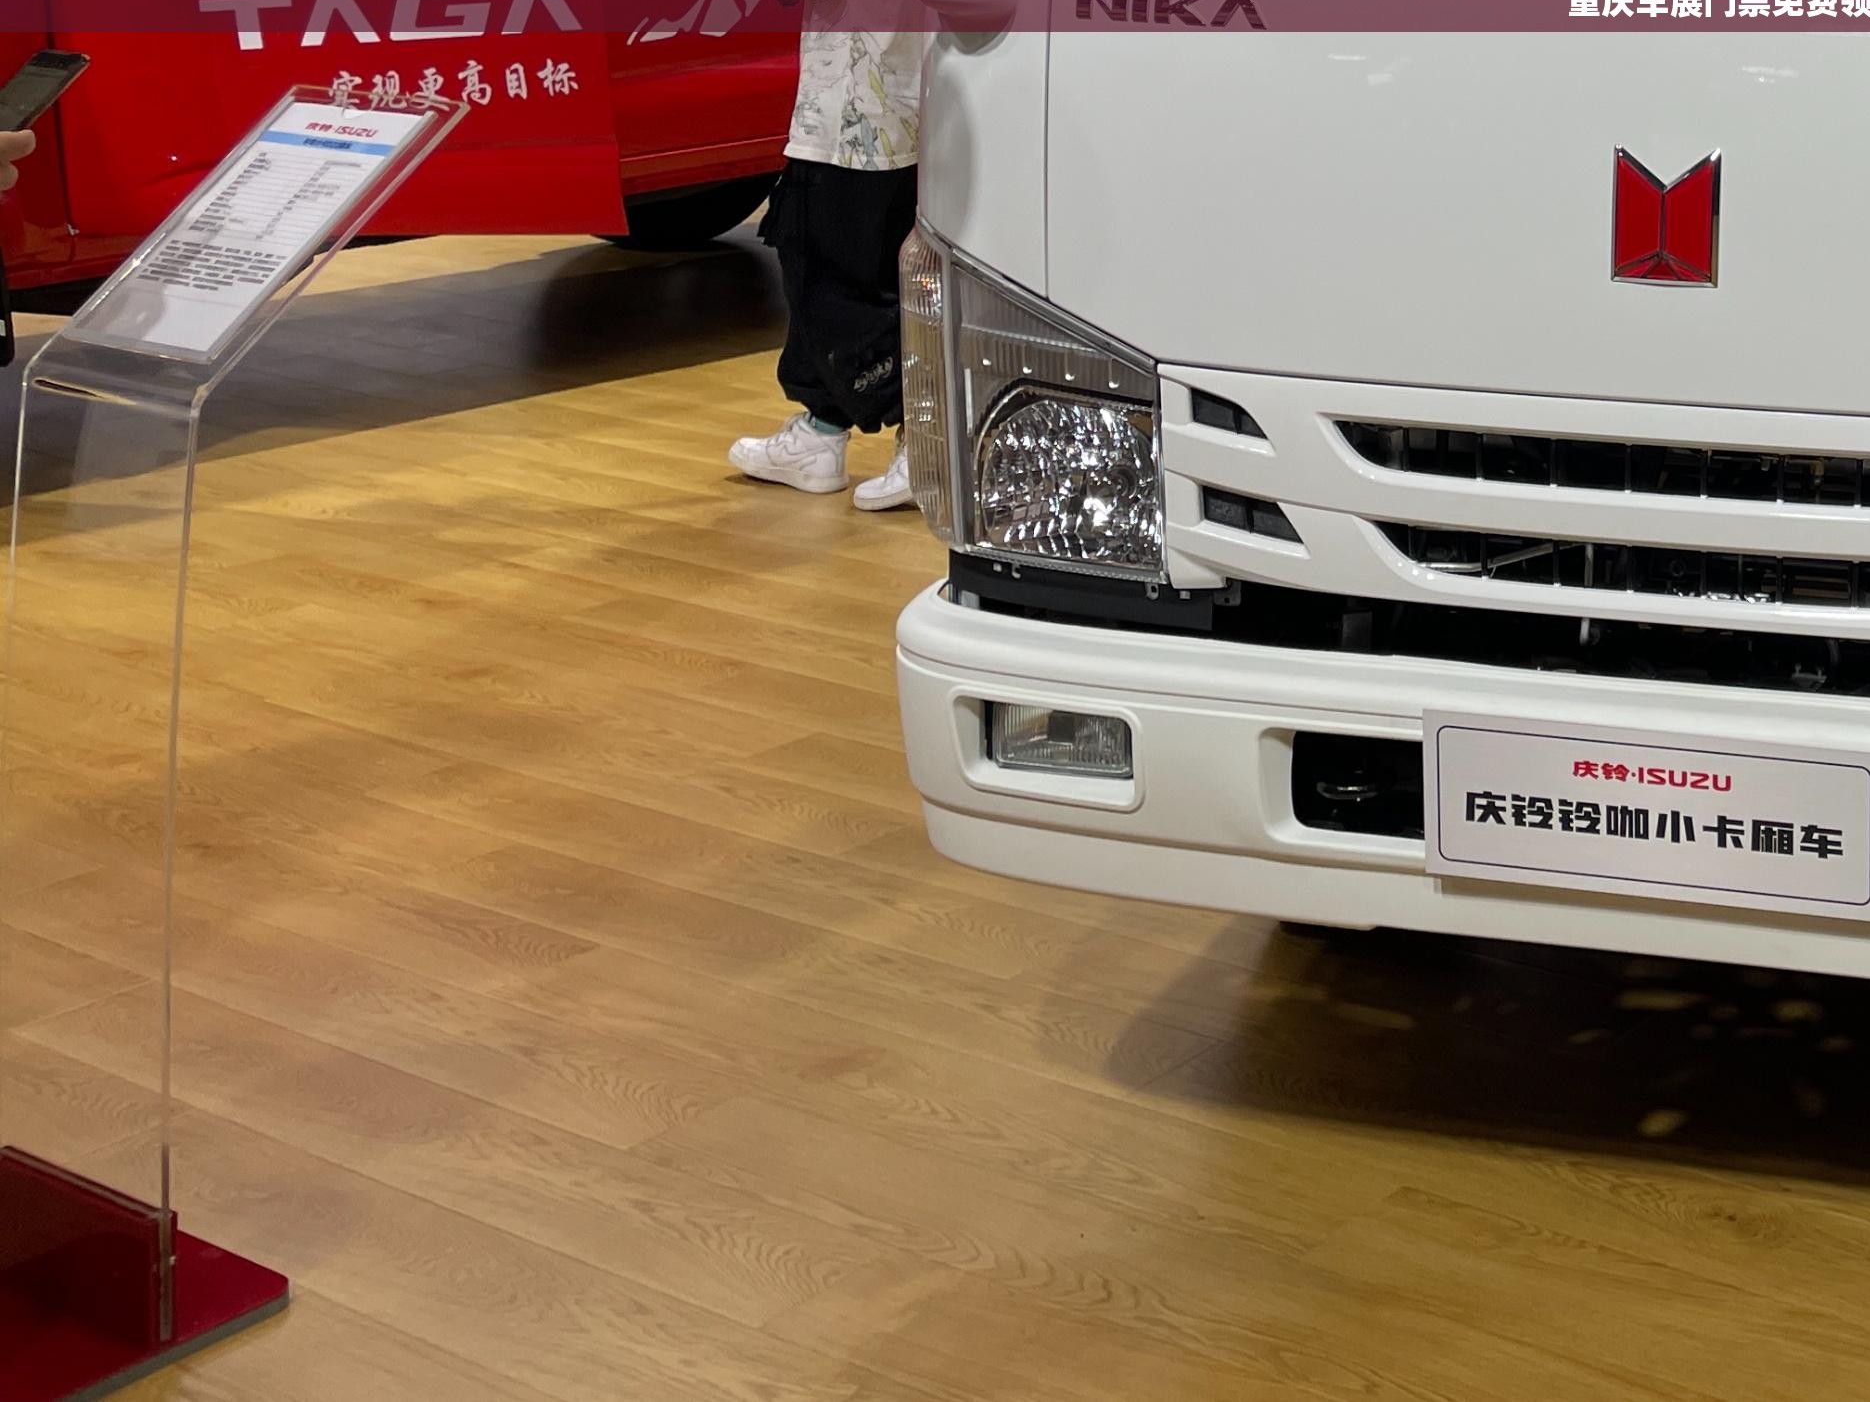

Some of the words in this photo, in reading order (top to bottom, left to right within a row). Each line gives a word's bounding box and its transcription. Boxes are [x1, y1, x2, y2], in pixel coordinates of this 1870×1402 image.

[329, 57, 579, 113] 实现更高目标
[1572, 760, 1733, 792] 庆铃·ISUZU
[1465, 790, 1844, 860] 庆铃铃咖小卡厢车
